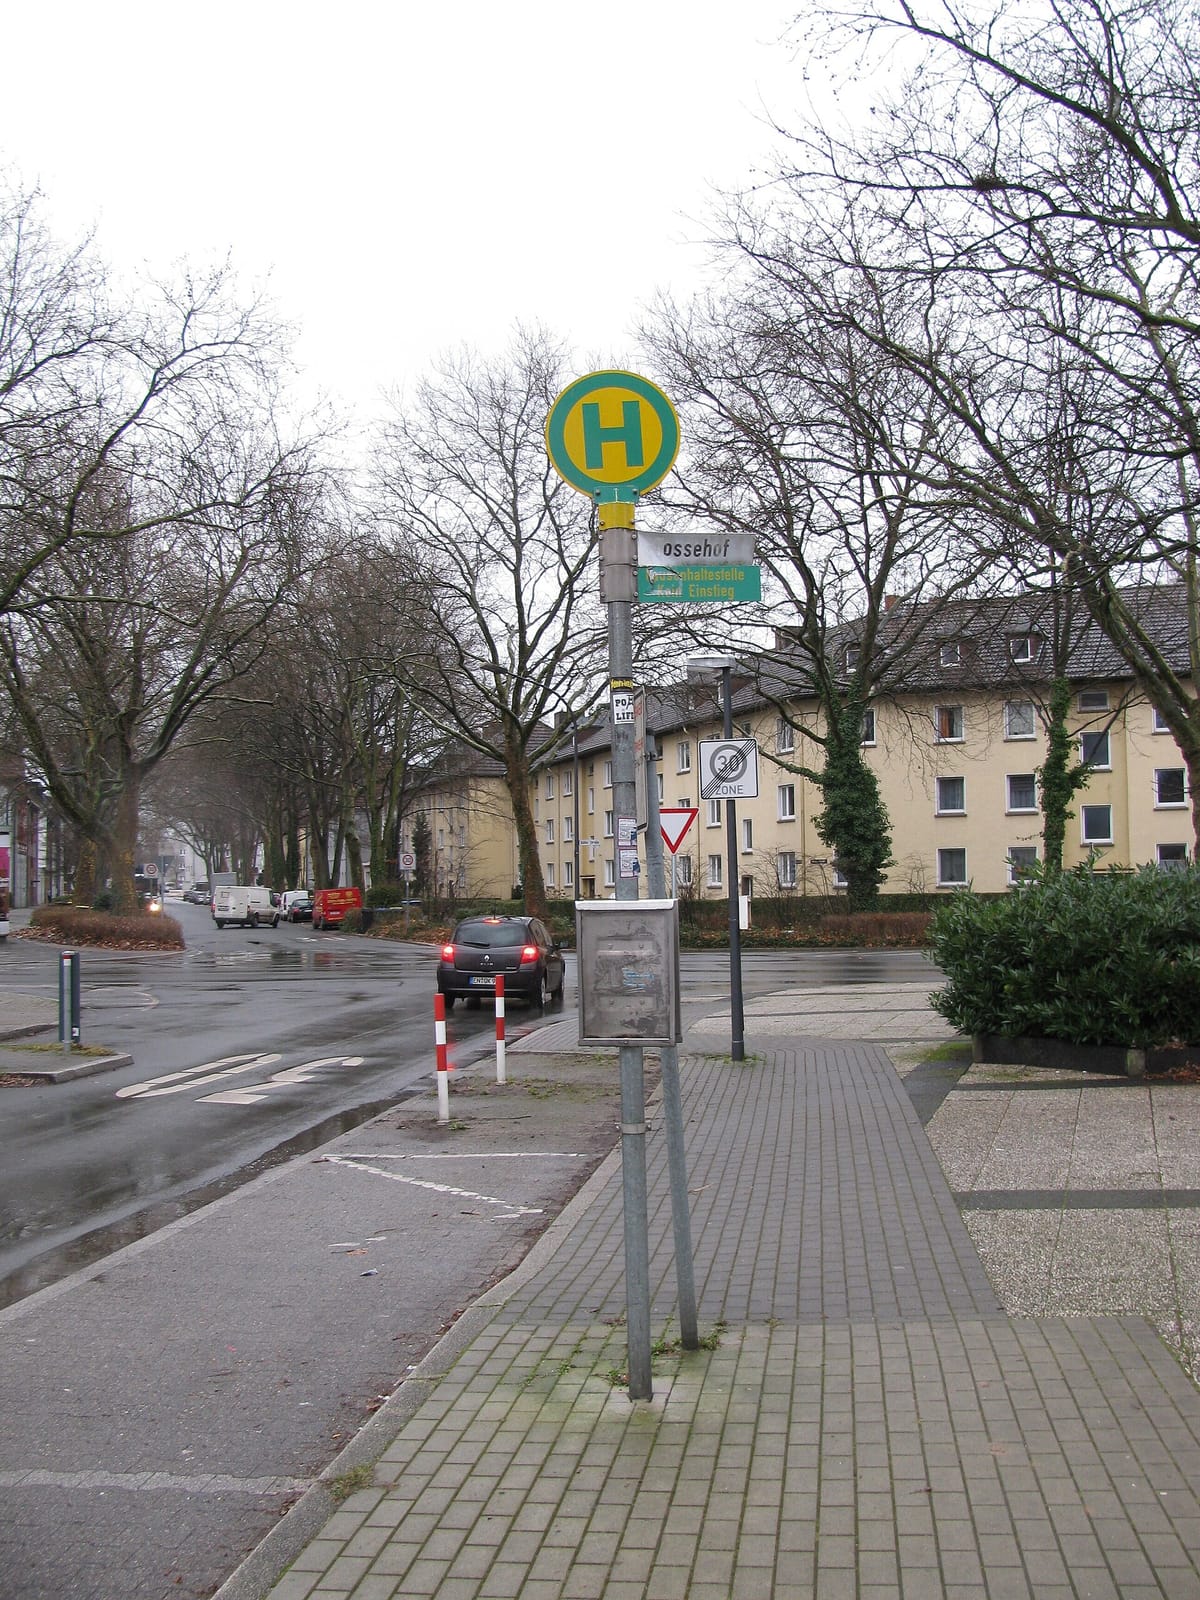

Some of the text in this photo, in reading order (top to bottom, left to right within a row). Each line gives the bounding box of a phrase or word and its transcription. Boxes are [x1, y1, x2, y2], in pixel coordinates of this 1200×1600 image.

[582, 400, 644, 470] H
[663, 538, 730, 558] ossehof
[688, 584, 735, 599] Einstieg
[715, 784, 744, 795] ZONE
